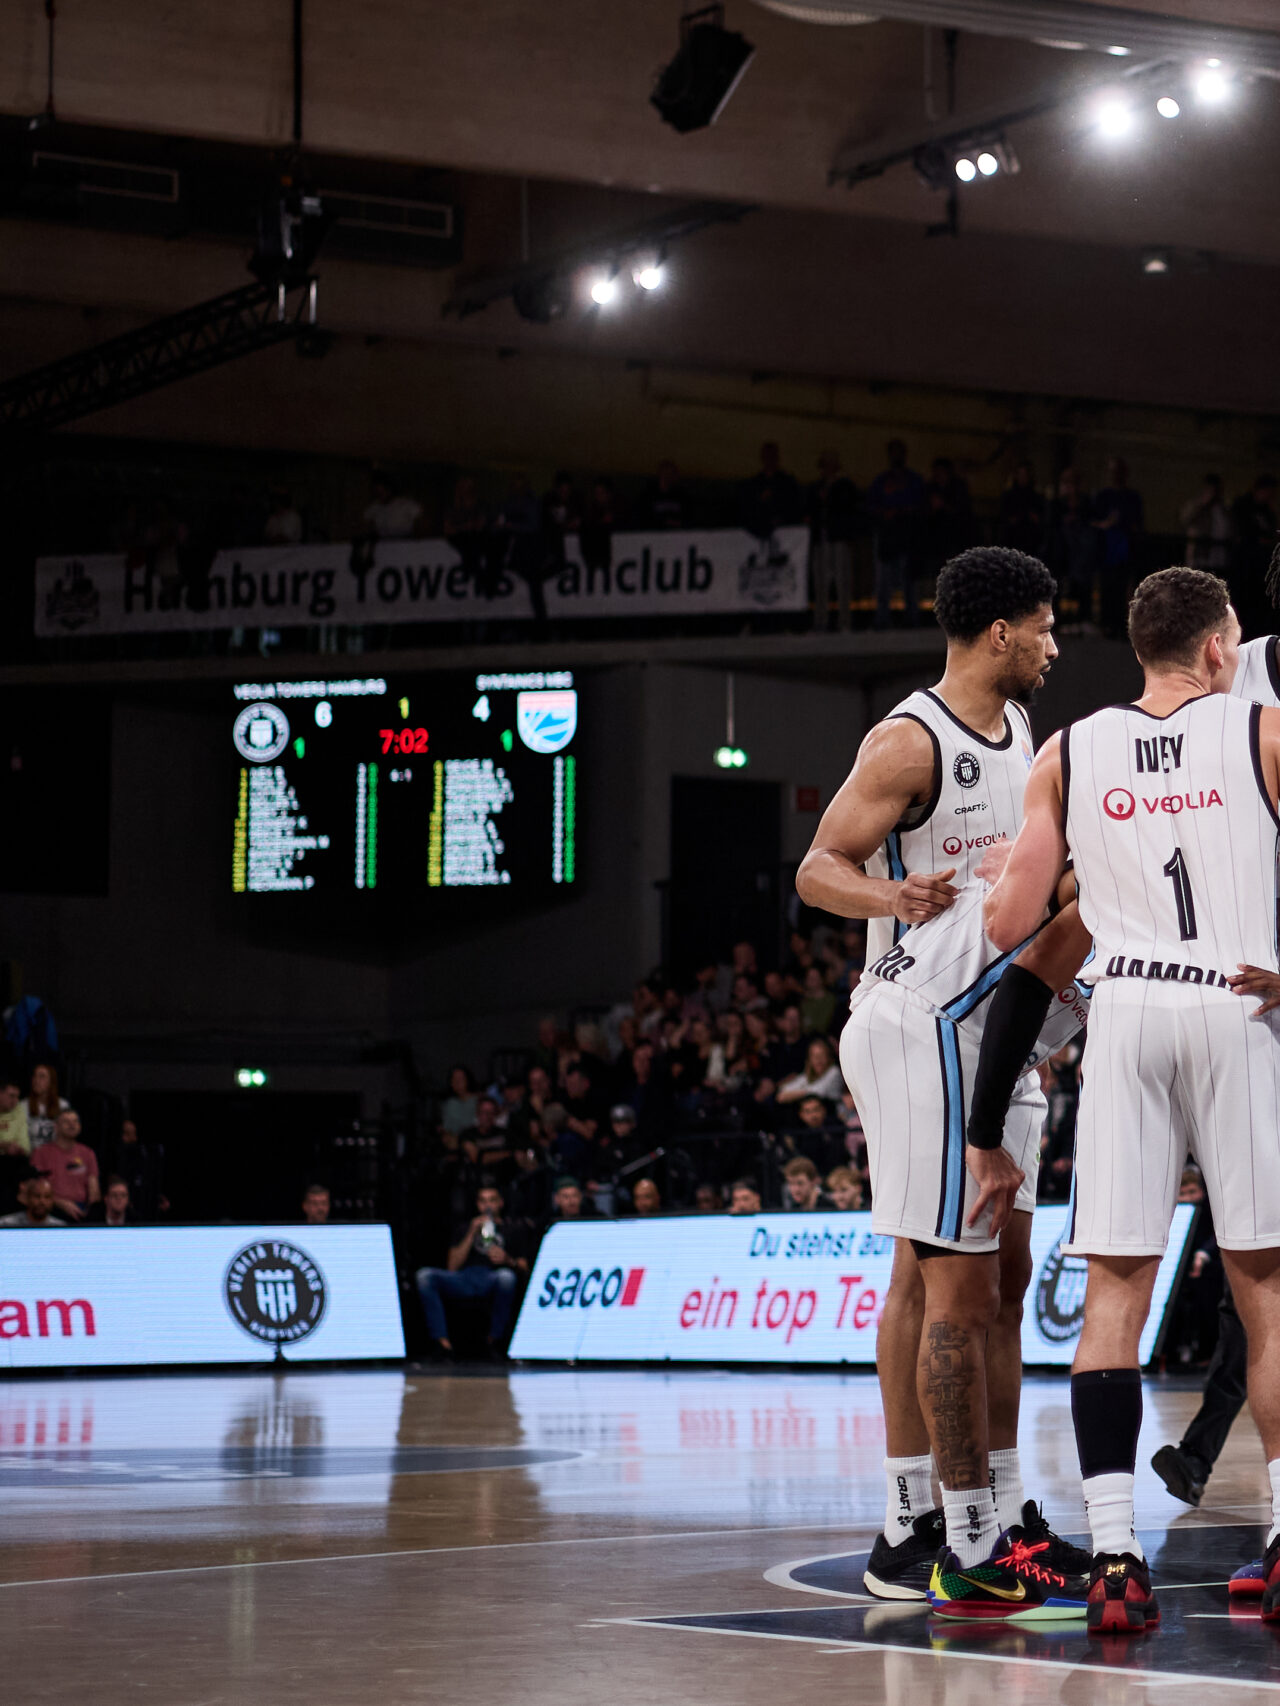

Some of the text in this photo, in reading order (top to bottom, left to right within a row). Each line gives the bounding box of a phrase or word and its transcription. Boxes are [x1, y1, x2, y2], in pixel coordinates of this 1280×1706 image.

[124, 562, 336, 617] Hburg
[545, 546, 713, 598] anclub
[315, 701, 332, 727] 6
[472, 695, 490, 722] 4
[379, 728, 429, 754] 7:02
[1135, 733, 1184, 773] IVEY
[954, 803, 981, 815] CRAFT
[1142, 789, 1224, 814] VEOLIA
[1163, 847, 1198, 941] 1
[1071, 1001, 1088, 1027] VEO
[749, 1225, 895, 1258] Du stehst au
[538, 1266, 623, 1309] saco
[0, 1298, 96, 1338] am
[679, 1275, 885, 1345] ein top Te
[897, 1475, 911, 1512] CRAFT
[966, 1504, 980, 1530] CRAFT
